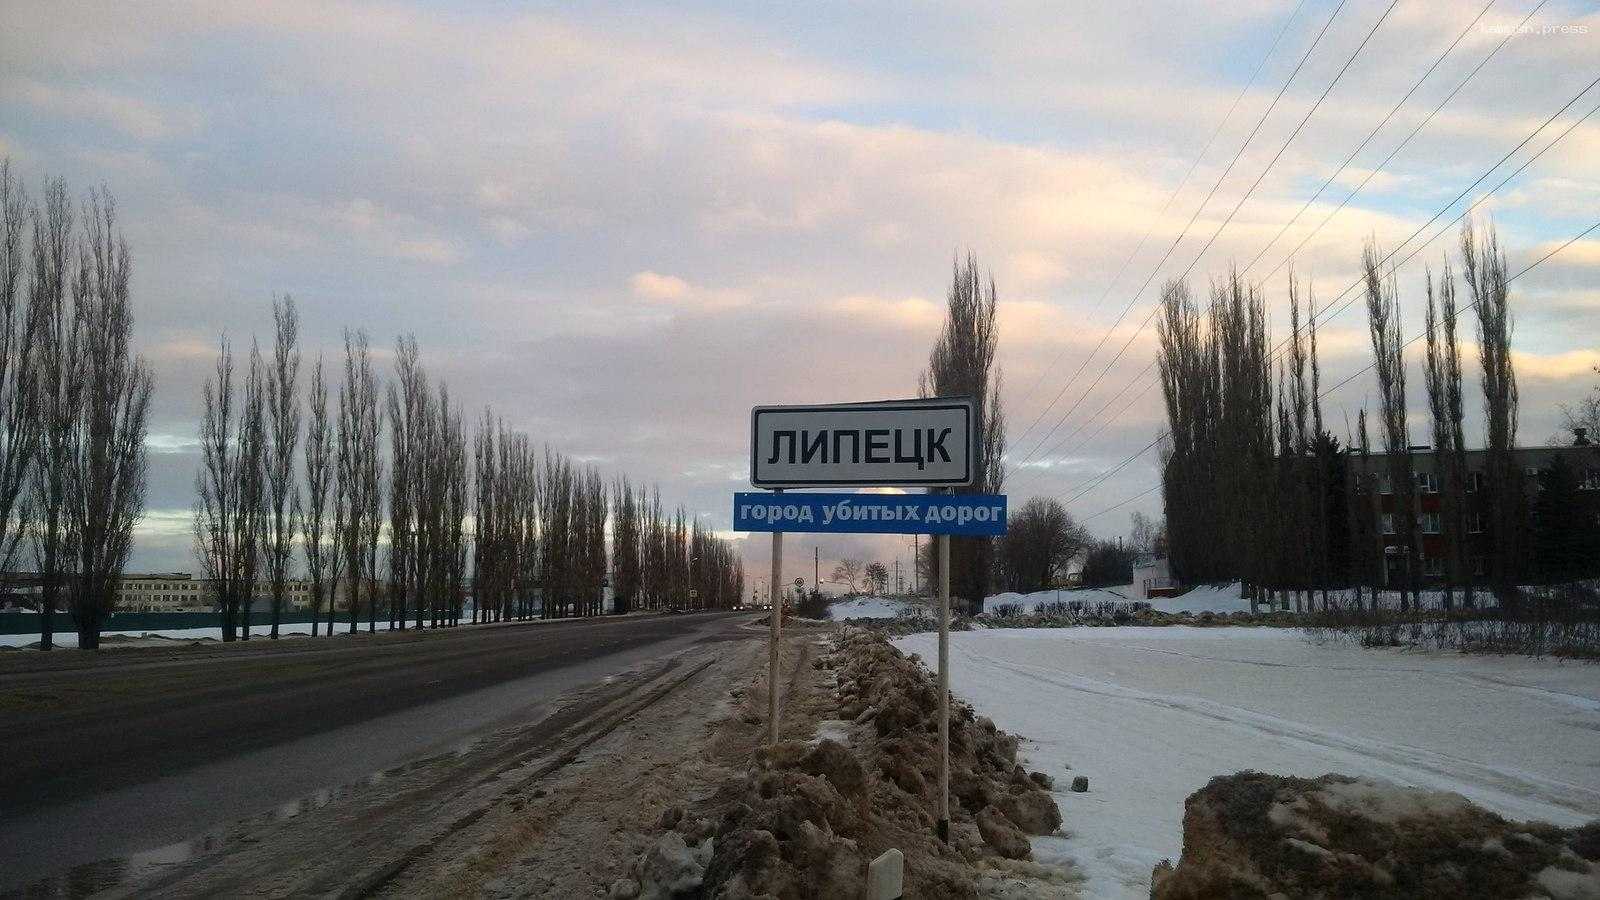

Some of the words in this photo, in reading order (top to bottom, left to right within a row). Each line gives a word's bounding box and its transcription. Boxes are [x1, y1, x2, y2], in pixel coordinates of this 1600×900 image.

[768, 428, 952, 470] ЛИПЕЦК
[740, 503, 814, 524] город
[822, 500, 920, 525] убитых
[924, 504, 1002, 525] дорог
